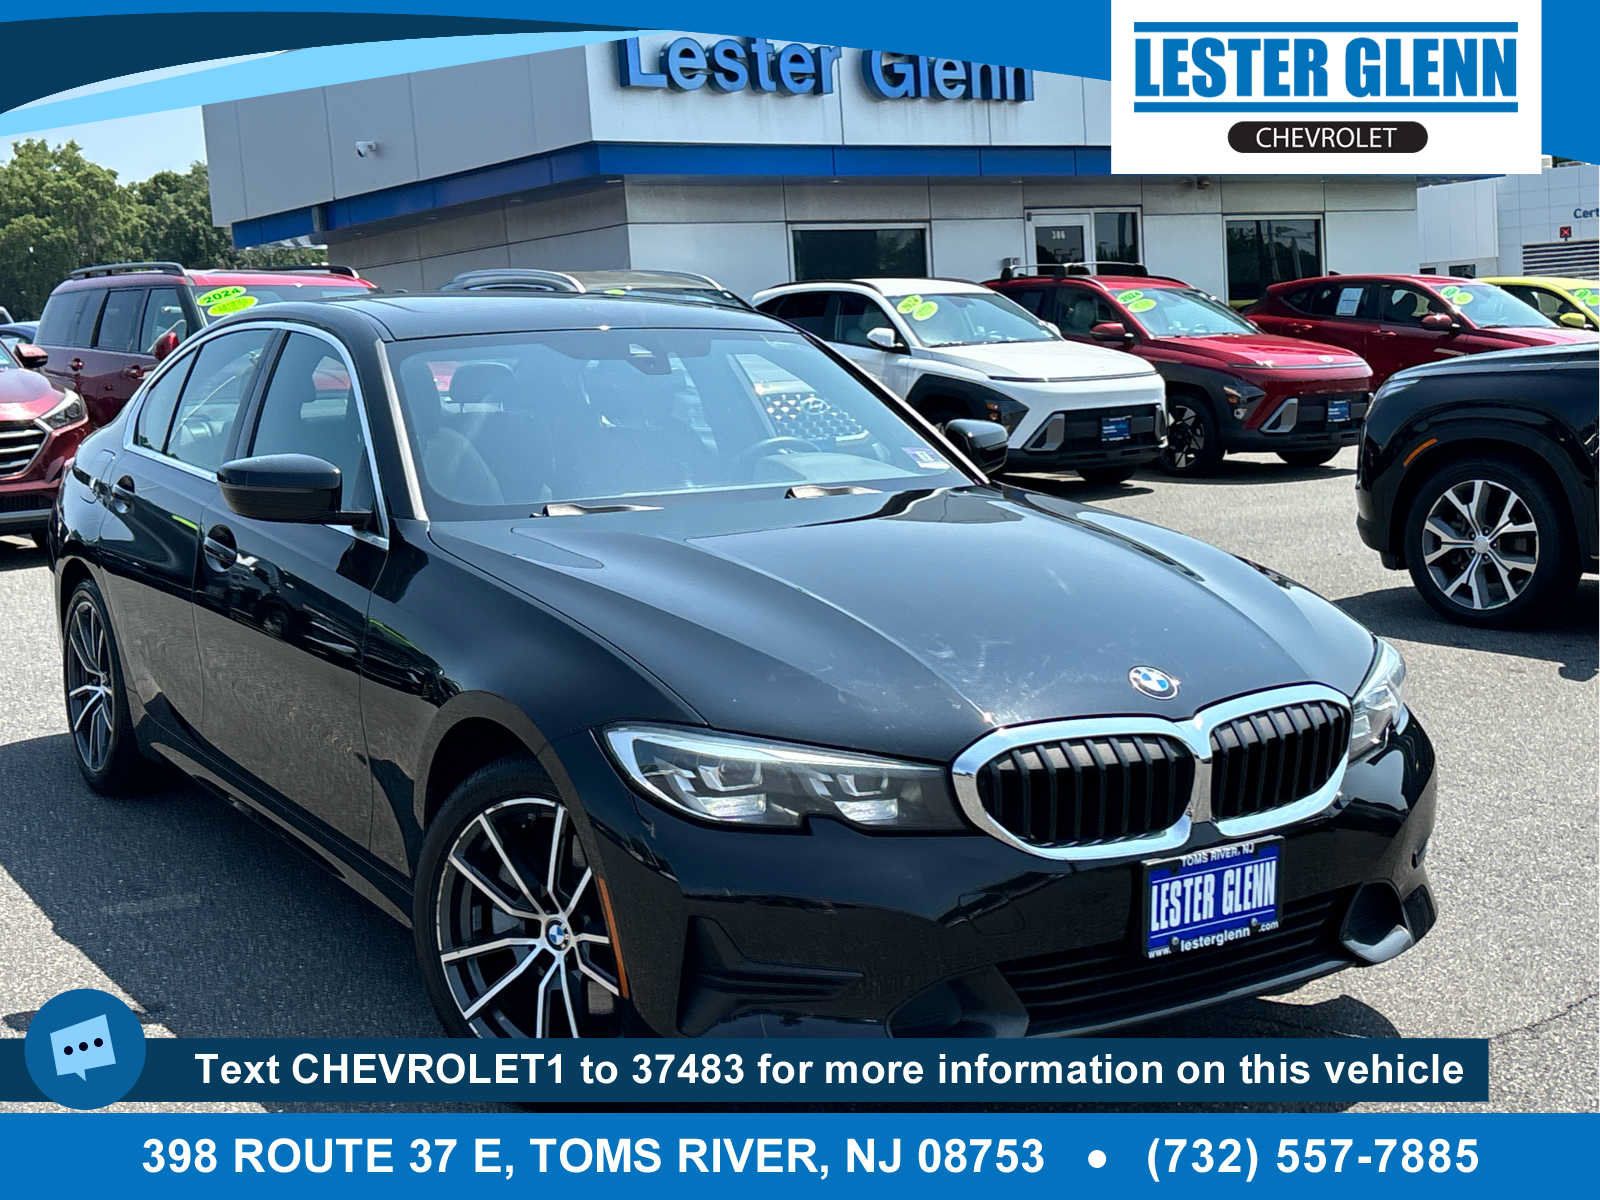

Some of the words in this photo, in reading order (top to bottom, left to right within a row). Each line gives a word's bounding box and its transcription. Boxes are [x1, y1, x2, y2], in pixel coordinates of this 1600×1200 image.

[618, 36, 842, 95] Lester
[204, 287, 241, 303] 2024
[1181, 851, 1209, 867] TOMS
[1242, 842, 1254, 855] NJ
[1150, 873, 1215, 931] LESTER
[1222, 860, 1277, 916] GLENN
